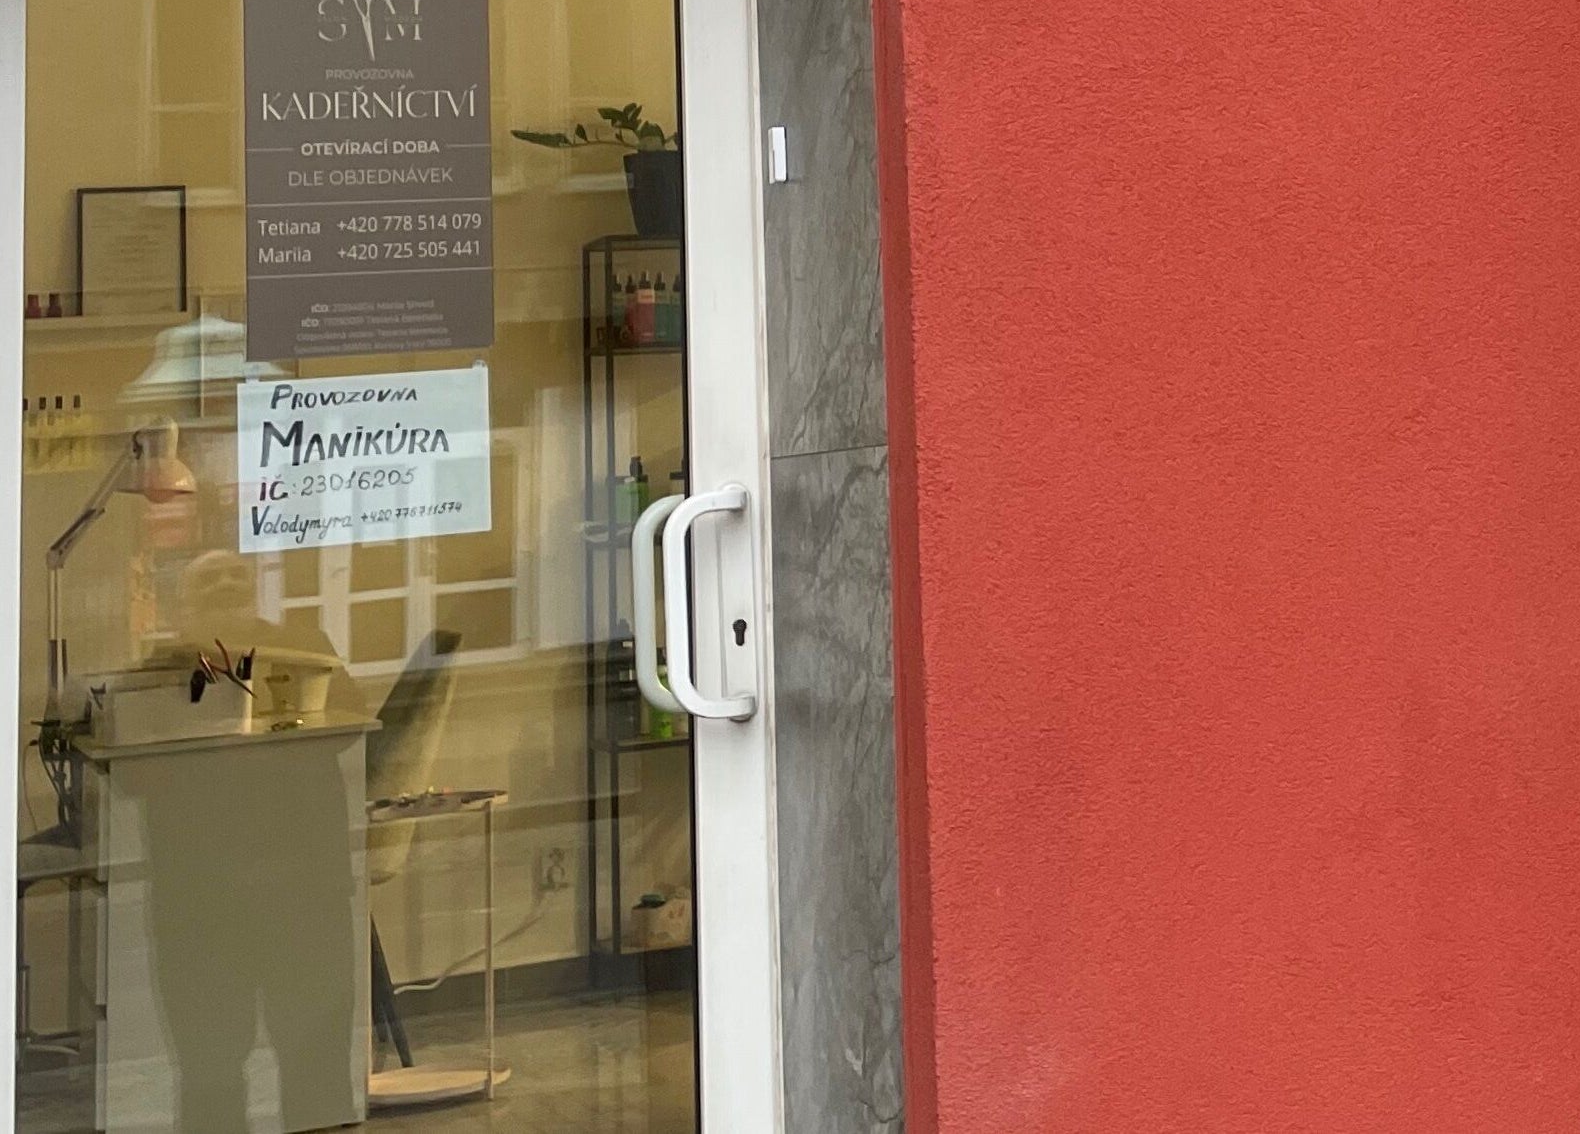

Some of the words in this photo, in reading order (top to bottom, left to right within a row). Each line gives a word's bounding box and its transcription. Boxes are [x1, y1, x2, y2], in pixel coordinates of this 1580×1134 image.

[324, 68, 415, 81] PROVOZOVNA
[261, 83, 478, 122] KADEŘNÍCTVÍ
[300, 139, 389, 157] OTEVÍRACÍ
[392, 140, 440, 155] DOBA
[287, 170, 324, 187] DLE
[329, 164, 454, 186] OBJEDNÁVEK
[258, 219, 321, 237] Tetiana
[336, 217, 378, 233] +420
[382, 215, 413, 232] 778
[417, 214, 447, 231] 514
[451, 213, 482, 230] 079
[337, 243, 379, 260] +420
[383, 242, 413, 259] 725
[417, 241, 448, 257] 505
[452, 240, 480, 256] 441
